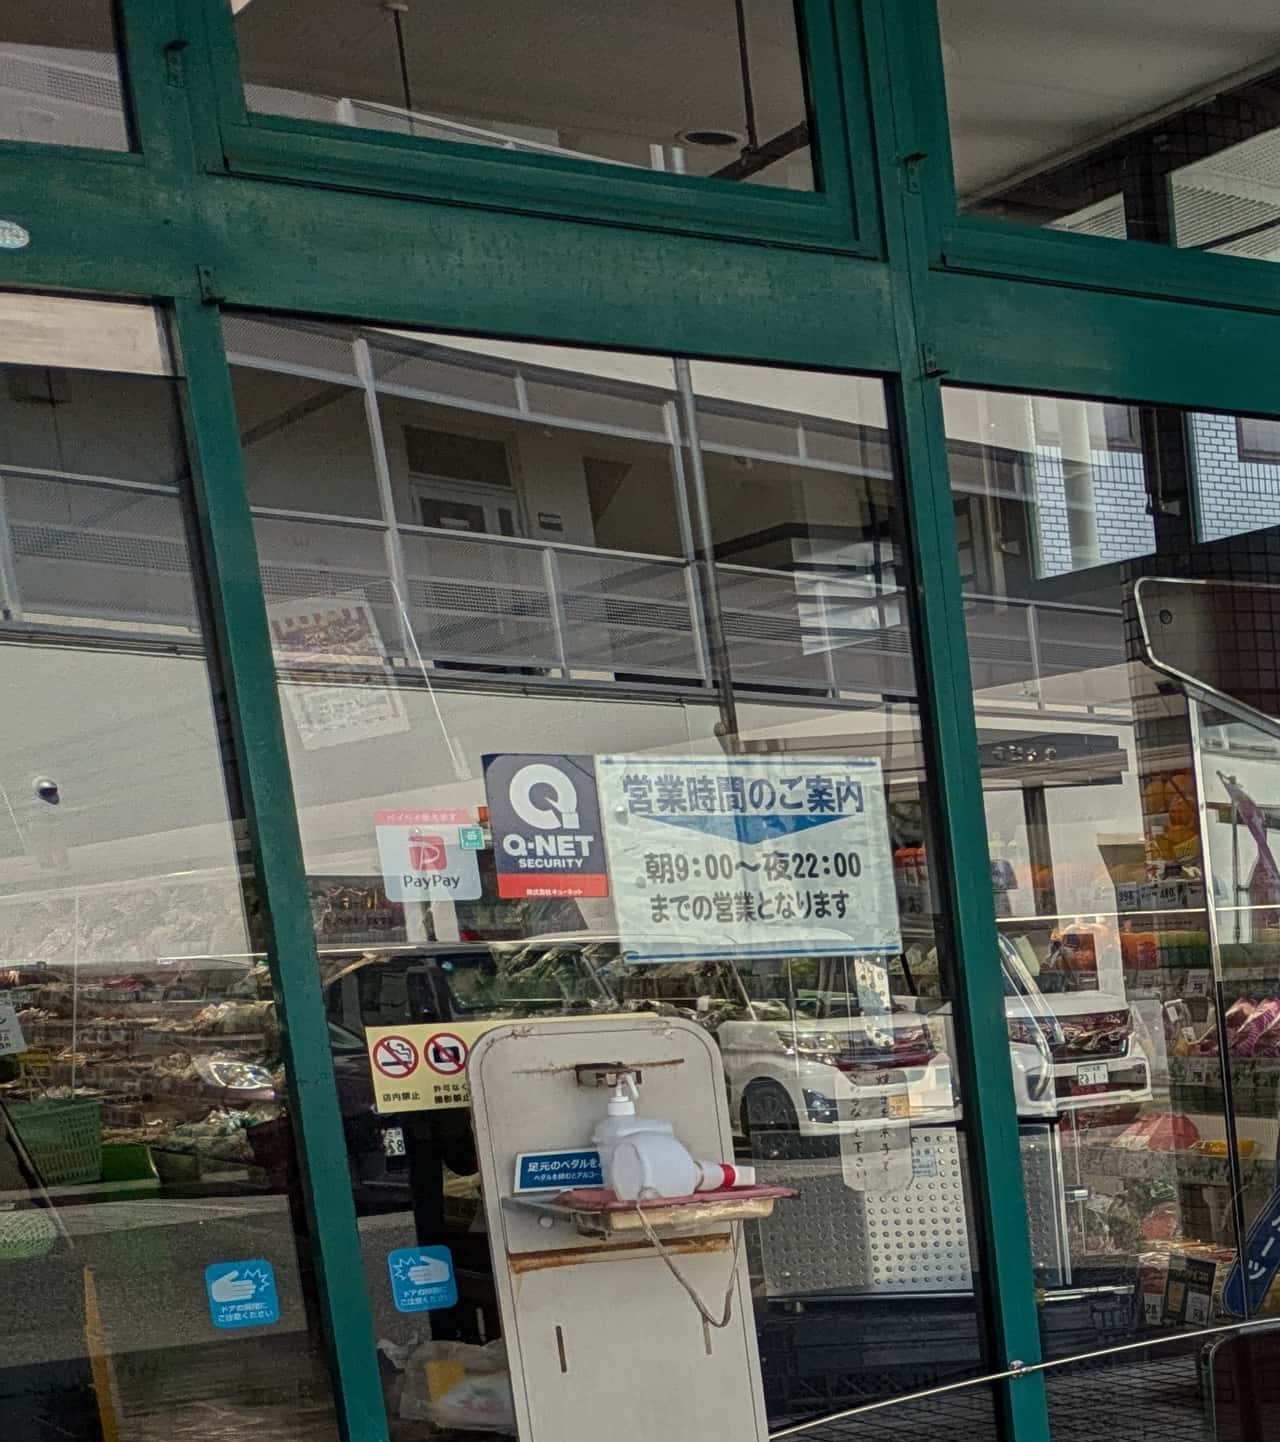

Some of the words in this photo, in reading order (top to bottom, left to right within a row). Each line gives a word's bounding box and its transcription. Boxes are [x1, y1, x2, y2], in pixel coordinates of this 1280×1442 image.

[623, 774, 865, 813] 営業時間のご案内
[519, 858, 583, 868] SECURITY
[403, 874, 460, 890] PayPay
[650, 890, 850, 923] までの営業となります
[528, 1157, 600, 1172] 足元のペダルを
